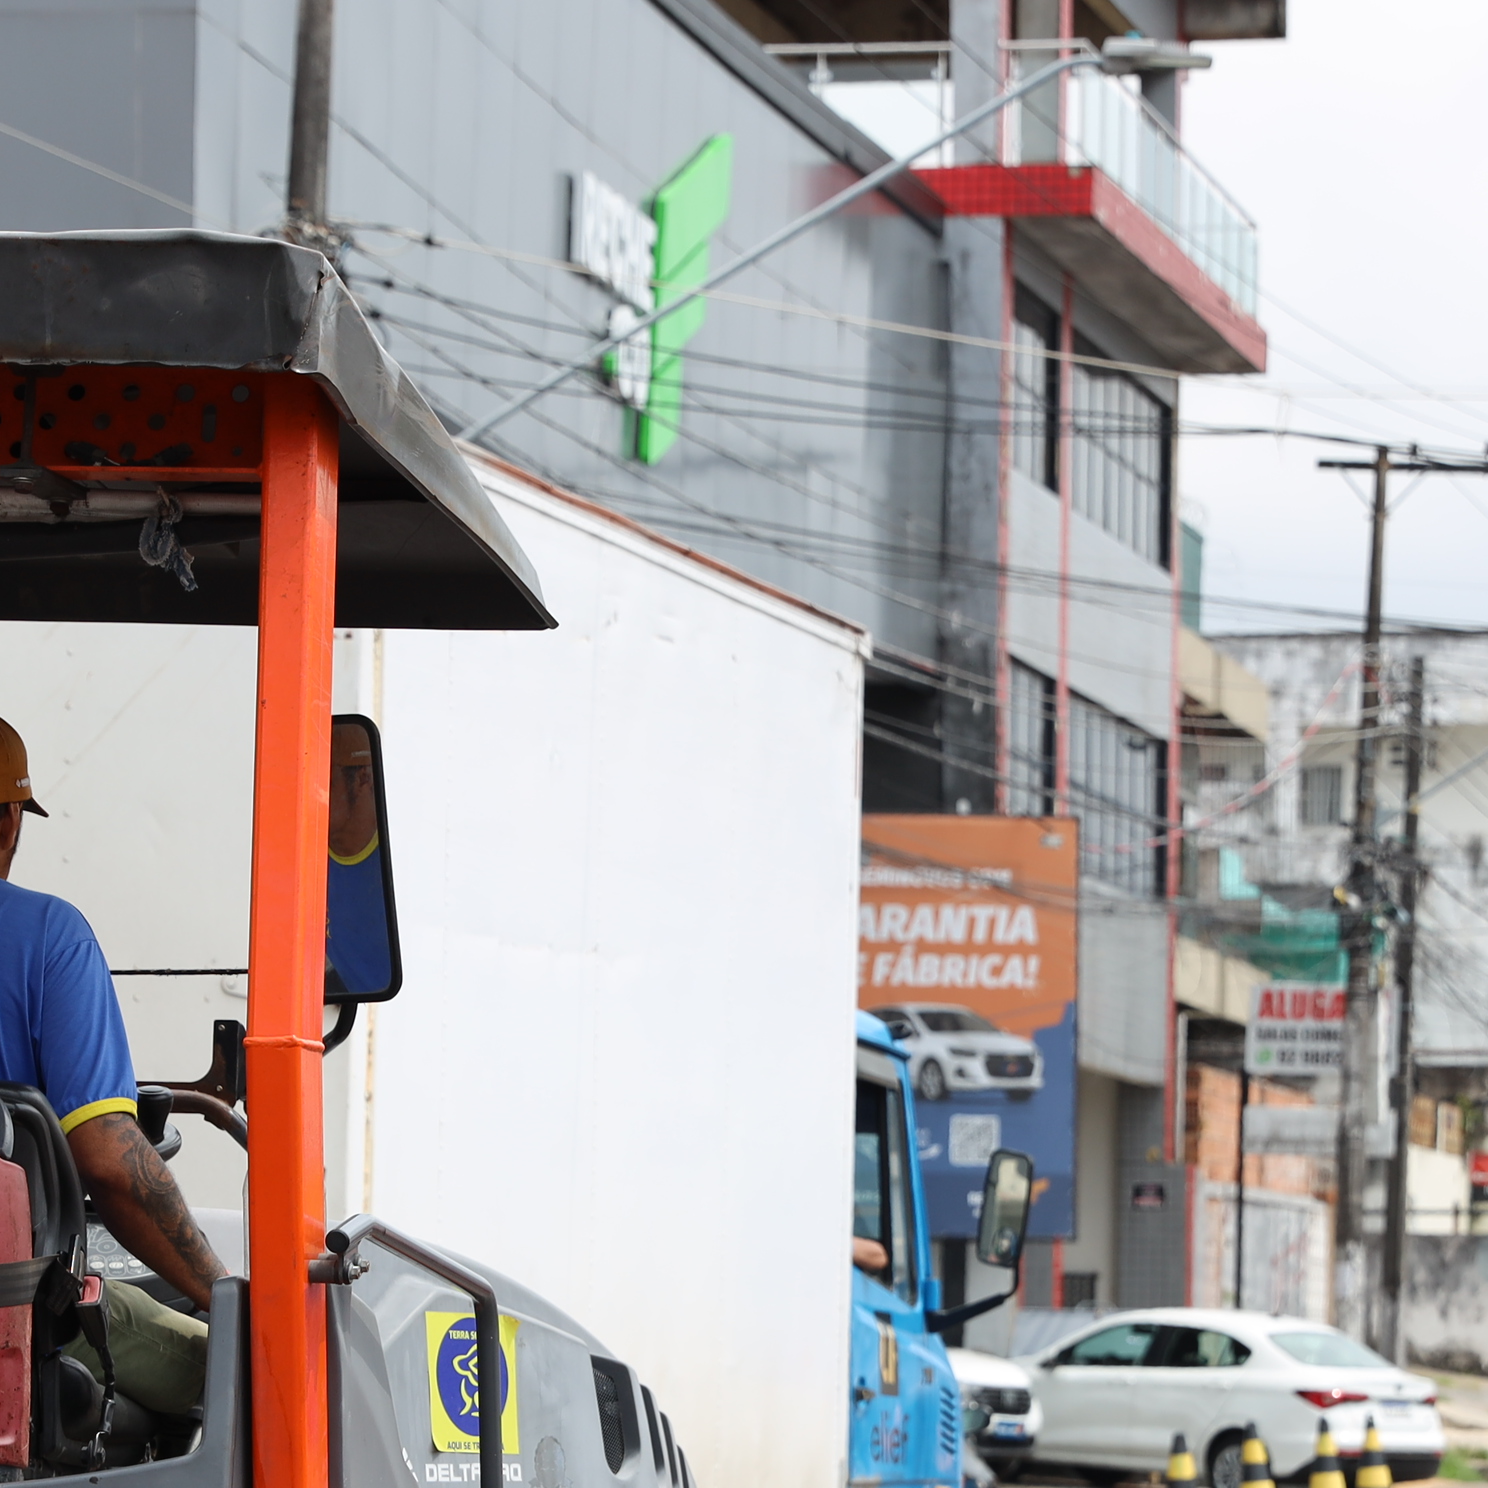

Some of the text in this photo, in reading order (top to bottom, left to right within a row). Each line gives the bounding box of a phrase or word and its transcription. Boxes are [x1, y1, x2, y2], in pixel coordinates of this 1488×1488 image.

[859, 902, 1039, 945] ARANTIA
[872, 942, 1041, 989] FÁBRICA!
[449, 1330, 470, 1340] TERRA
[447, 1440, 462, 1450] AQUI
[463, 1441, 473, 1450] SE
